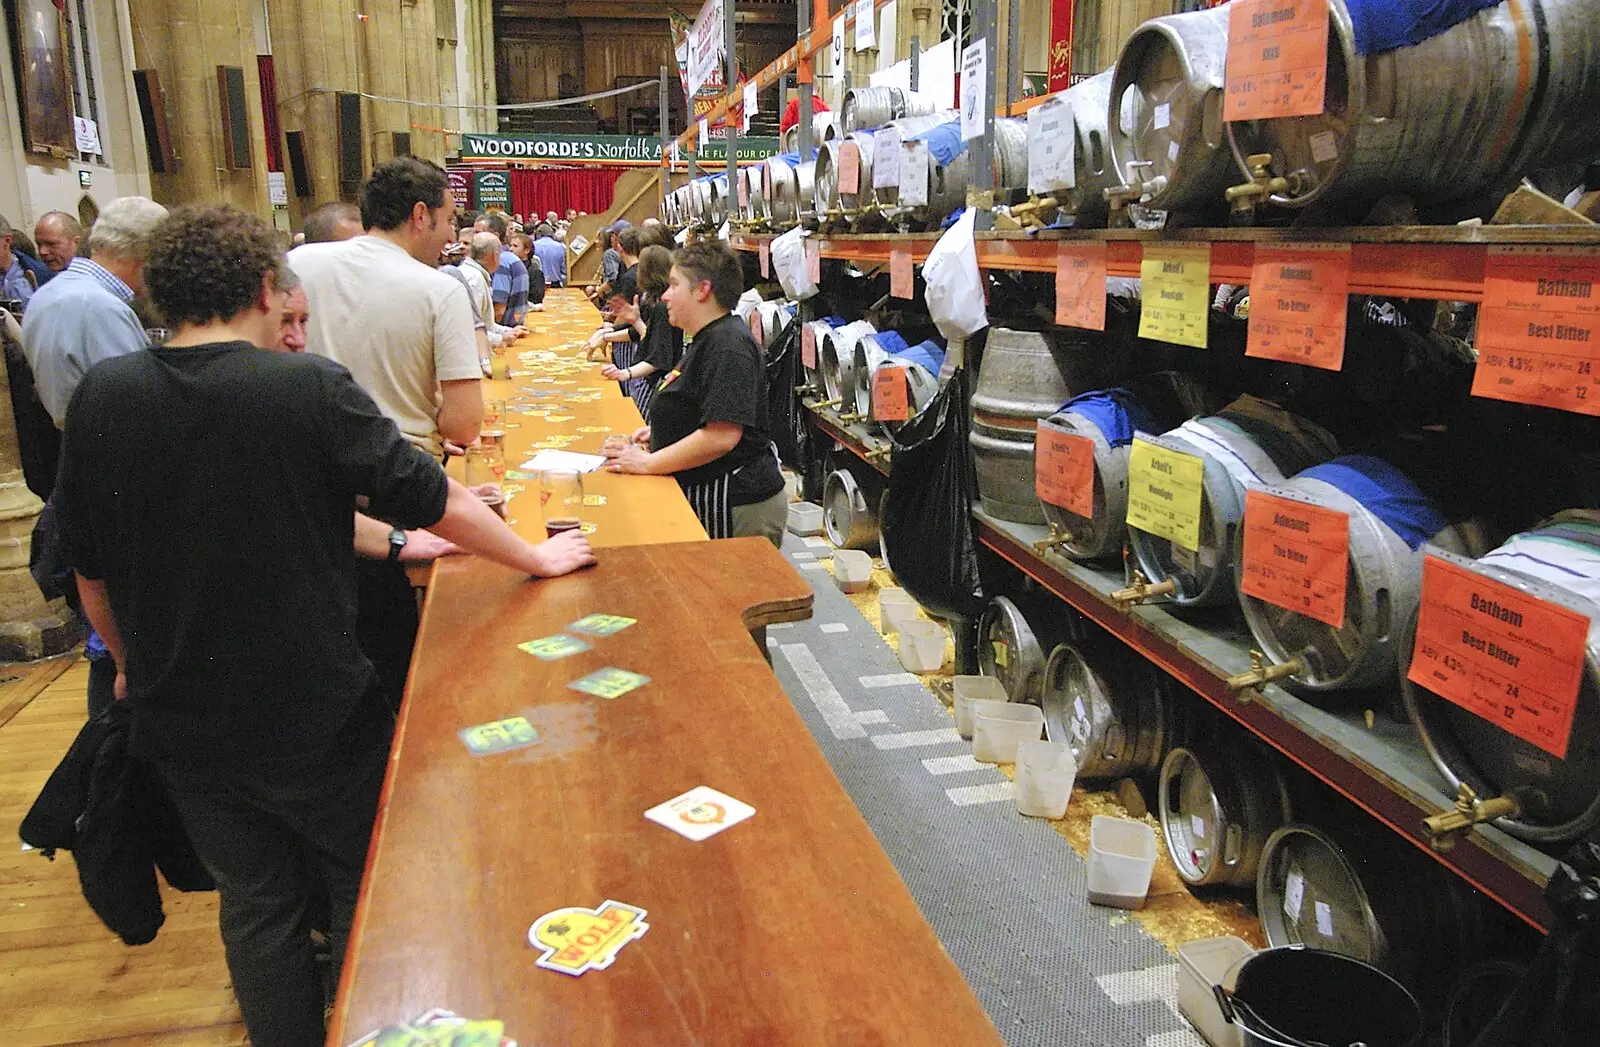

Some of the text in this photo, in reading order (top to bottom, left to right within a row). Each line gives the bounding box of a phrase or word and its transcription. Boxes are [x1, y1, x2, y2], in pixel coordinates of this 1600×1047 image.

[835, 35, 841, 66] 9
[469, 138, 594, 157] WOODFORDE'S
[596, 138, 651, 160] Norfolk
[713, 149, 756, 158] FLAOUR
[1536, 277, 1592, 298] Batham
[1528, 322, 1591, 341] Best Bitter
[1577, 361, 1591, 375] 24
[1575, 386, 1587, 399] 12
[1470, 592, 1523, 628] Batham
[1462, 630, 1521, 668] Best Bitter
[1506, 683, 1520, 698] 24
[1503, 705, 1515, 719] 12
